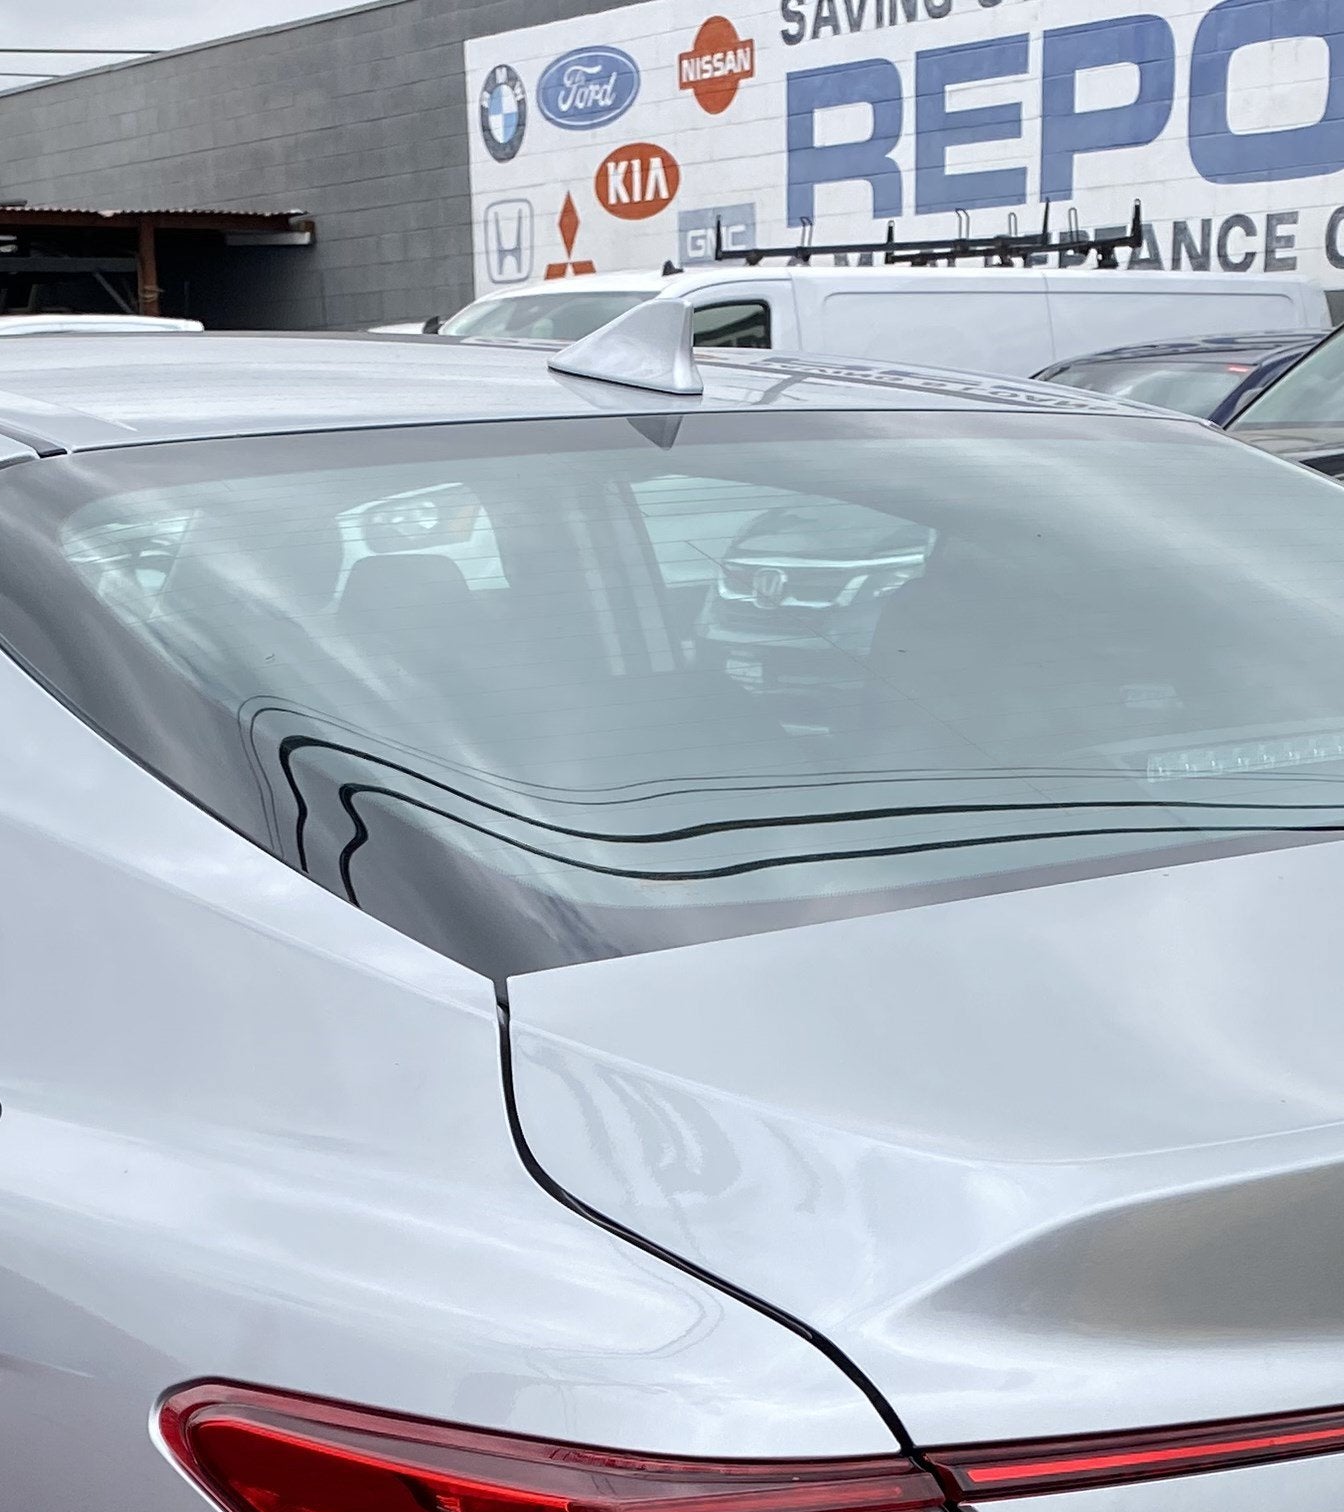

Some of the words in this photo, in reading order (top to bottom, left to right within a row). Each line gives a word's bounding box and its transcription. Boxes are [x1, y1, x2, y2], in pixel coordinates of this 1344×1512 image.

[681, 46, 751, 82] NISSAN
[558, 64, 618, 113] Ford
[607, 156, 670, 205] KIA
[686, 224, 747, 258] GMC
